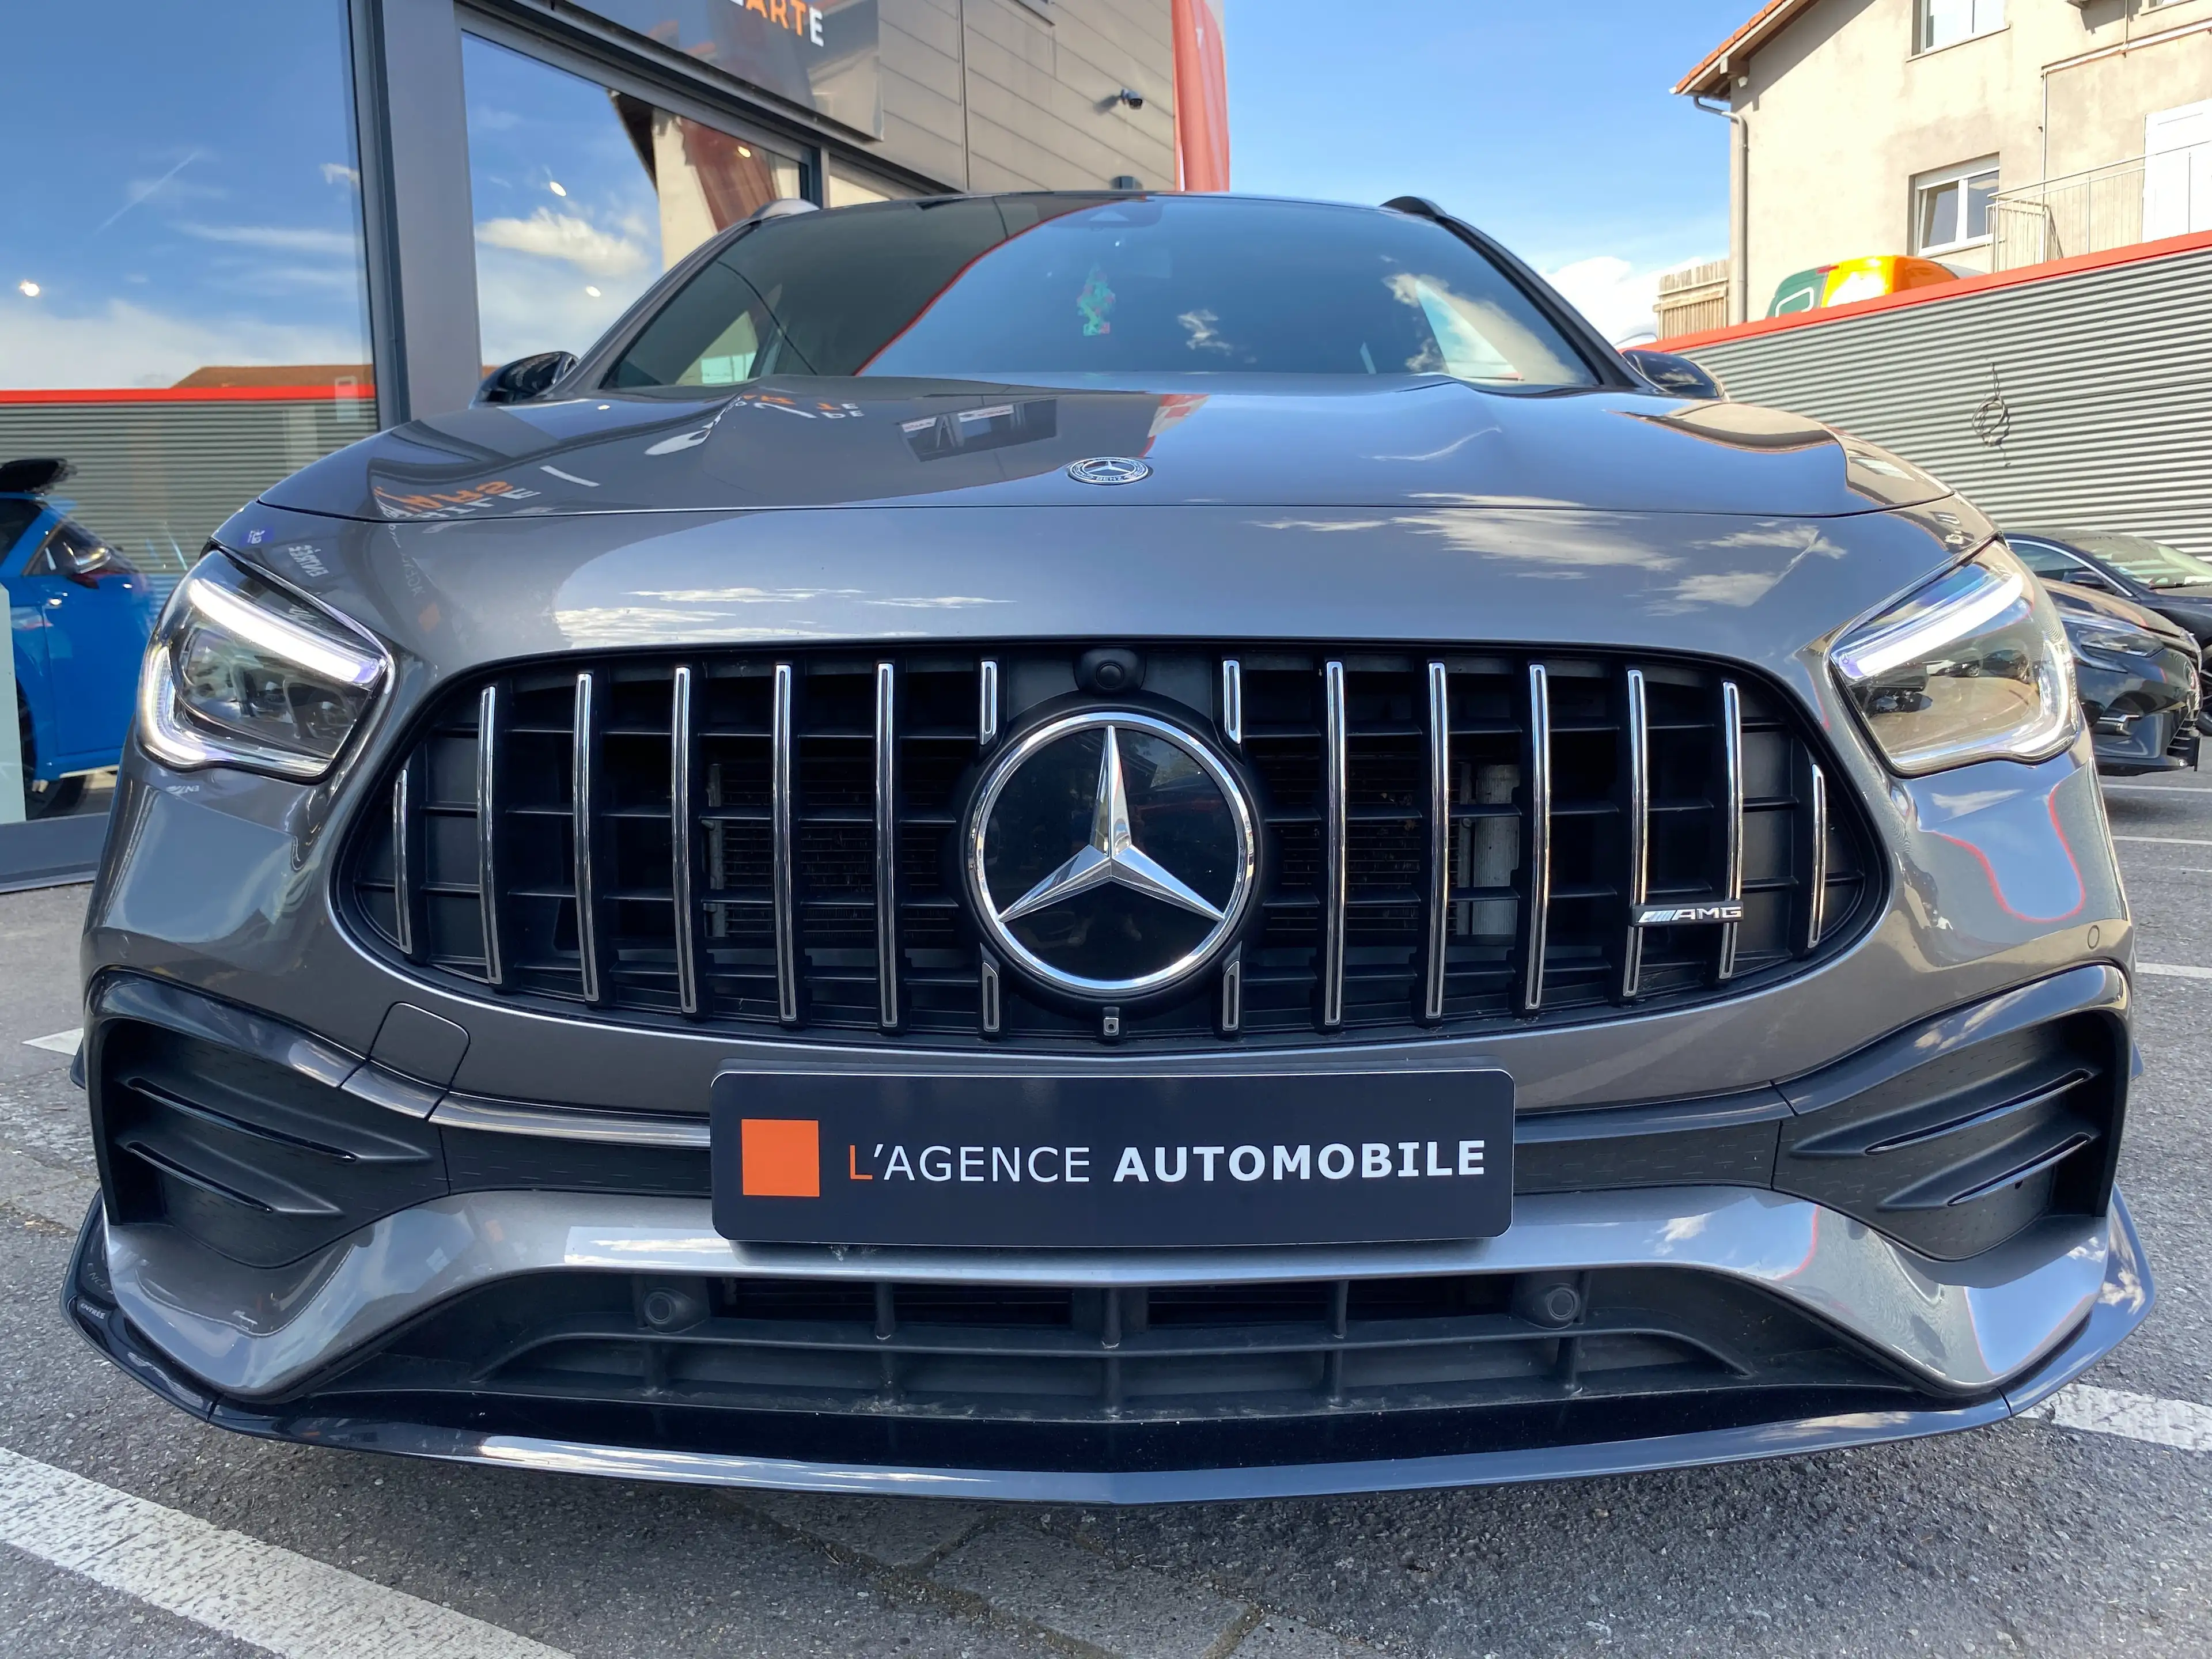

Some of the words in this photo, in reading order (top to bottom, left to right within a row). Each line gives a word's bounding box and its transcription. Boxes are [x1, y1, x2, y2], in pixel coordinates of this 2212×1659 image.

[729, 0, 824, 47] RTE
[1671, 906, 1743, 921] AMG
[849, 1143, 1090, 1183] L'AGENCE
[1113, 1140, 1485, 1183] AUTOMOBILE
